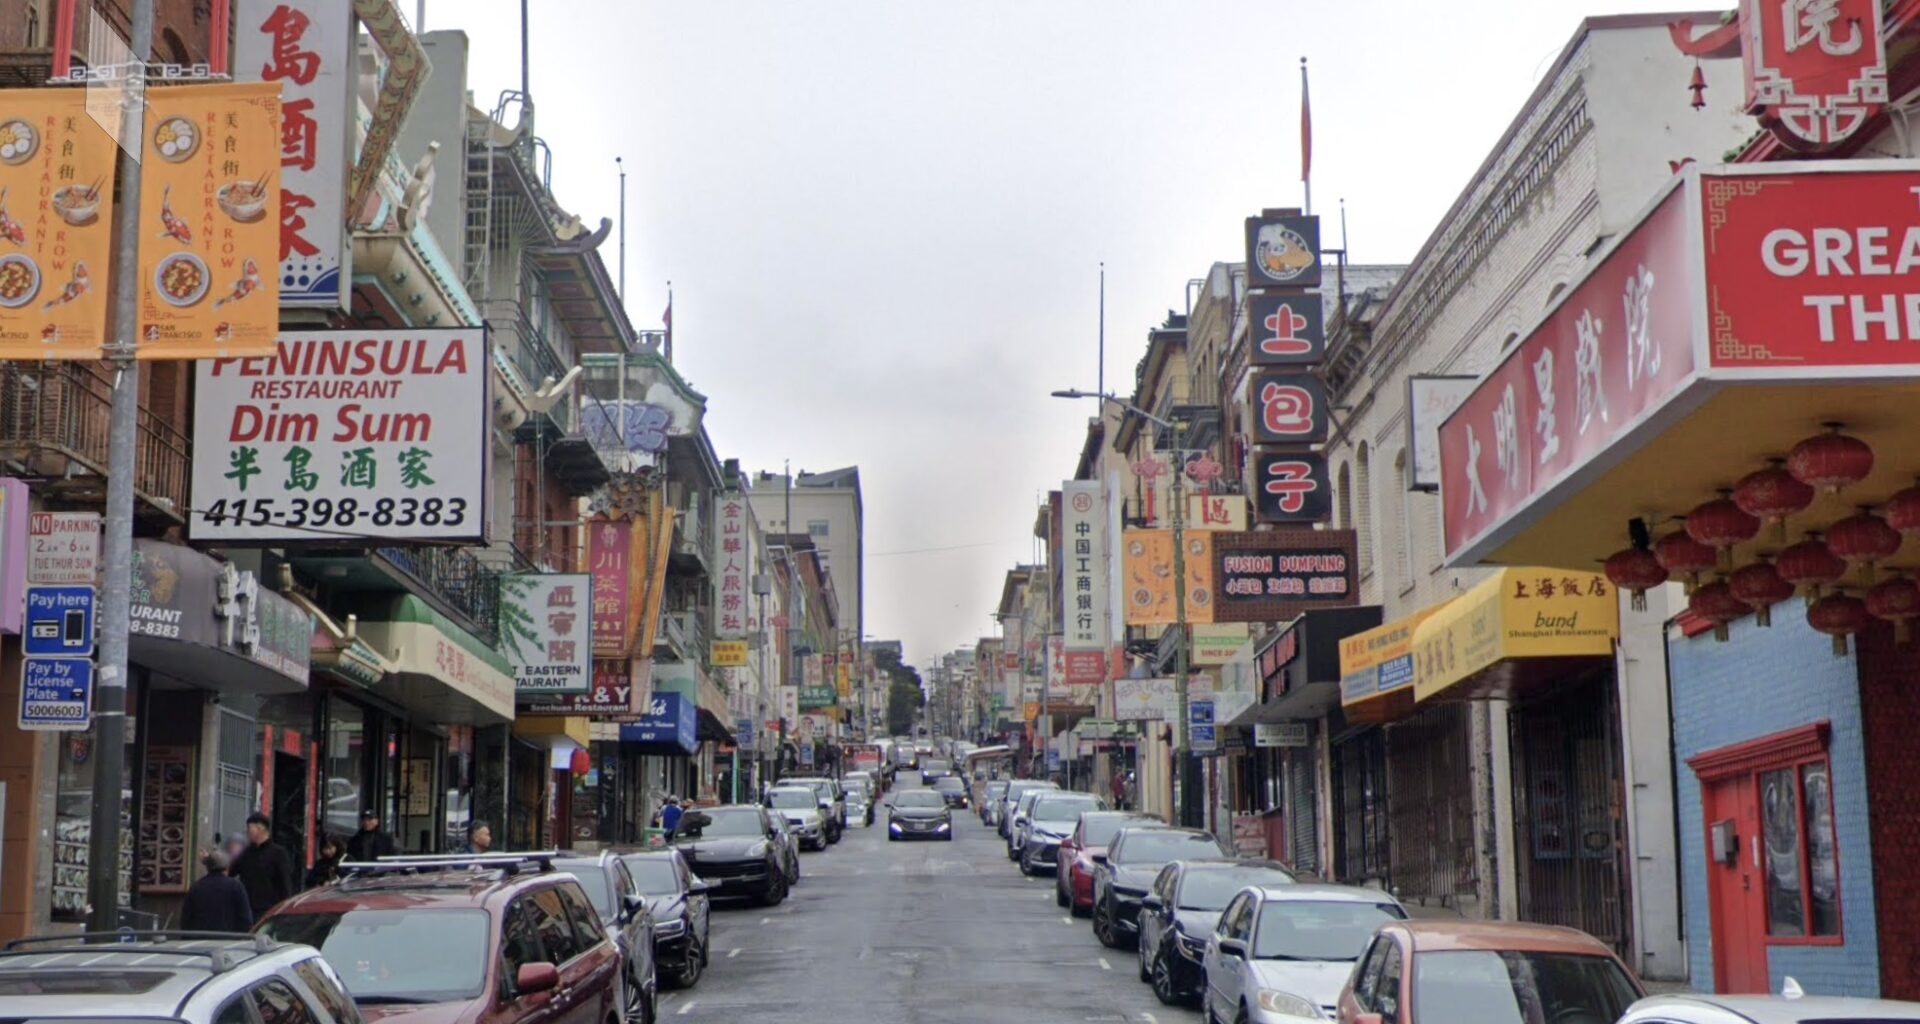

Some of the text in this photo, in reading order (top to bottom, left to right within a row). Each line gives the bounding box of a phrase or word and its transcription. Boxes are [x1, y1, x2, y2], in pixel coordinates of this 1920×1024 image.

[58, 115, 76, 181] 美食街
[221, 111, 240, 177] 美食街
[36, 116, 55, 253] RESTAURANT
[203, 112, 216, 251] RESTAURANT
[52, 231, 66, 271] ROW
[221, 228, 235, 269] ROW
[251, 380, 402, 399] RESTAURANT
[1260, 303, 1318, 513] 土包子
[229, 403, 431, 442] Dim Sum
[224, 445, 436, 492] 半島酒家
[203, 498, 467, 527] 415-398-8383
[31, 515, 97, 534] NO PARKING
[36, 539, 45, 552] 2
[69, 537, 77, 552] 6
[35, 558, 92, 569] TUE THUR SUN
[722, 501, 742, 630] 金山華人服務社
[1224, 555, 1345, 573] FUSION DUMPLING
[1075, 521, 1093, 630] 中国工商银行
[1513, 576, 1607, 599] 上海飯店
[30, 592, 89, 606] Pay here
[1535, 610, 1578, 629] bund
[1508, 629, 1608, 638] Shanghai Restaurant
[28, 661, 71, 676] Pay by
[525, 666, 581, 675] EASTERN
[27, 674, 74, 687] License
[26, 687, 59, 700] Plate
[594, 686, 610, 703] &
[614, 686, 631, 703] Y
[27, 705, 82, 716] 50006003
[574, 703, 629, 713] Restaurant
